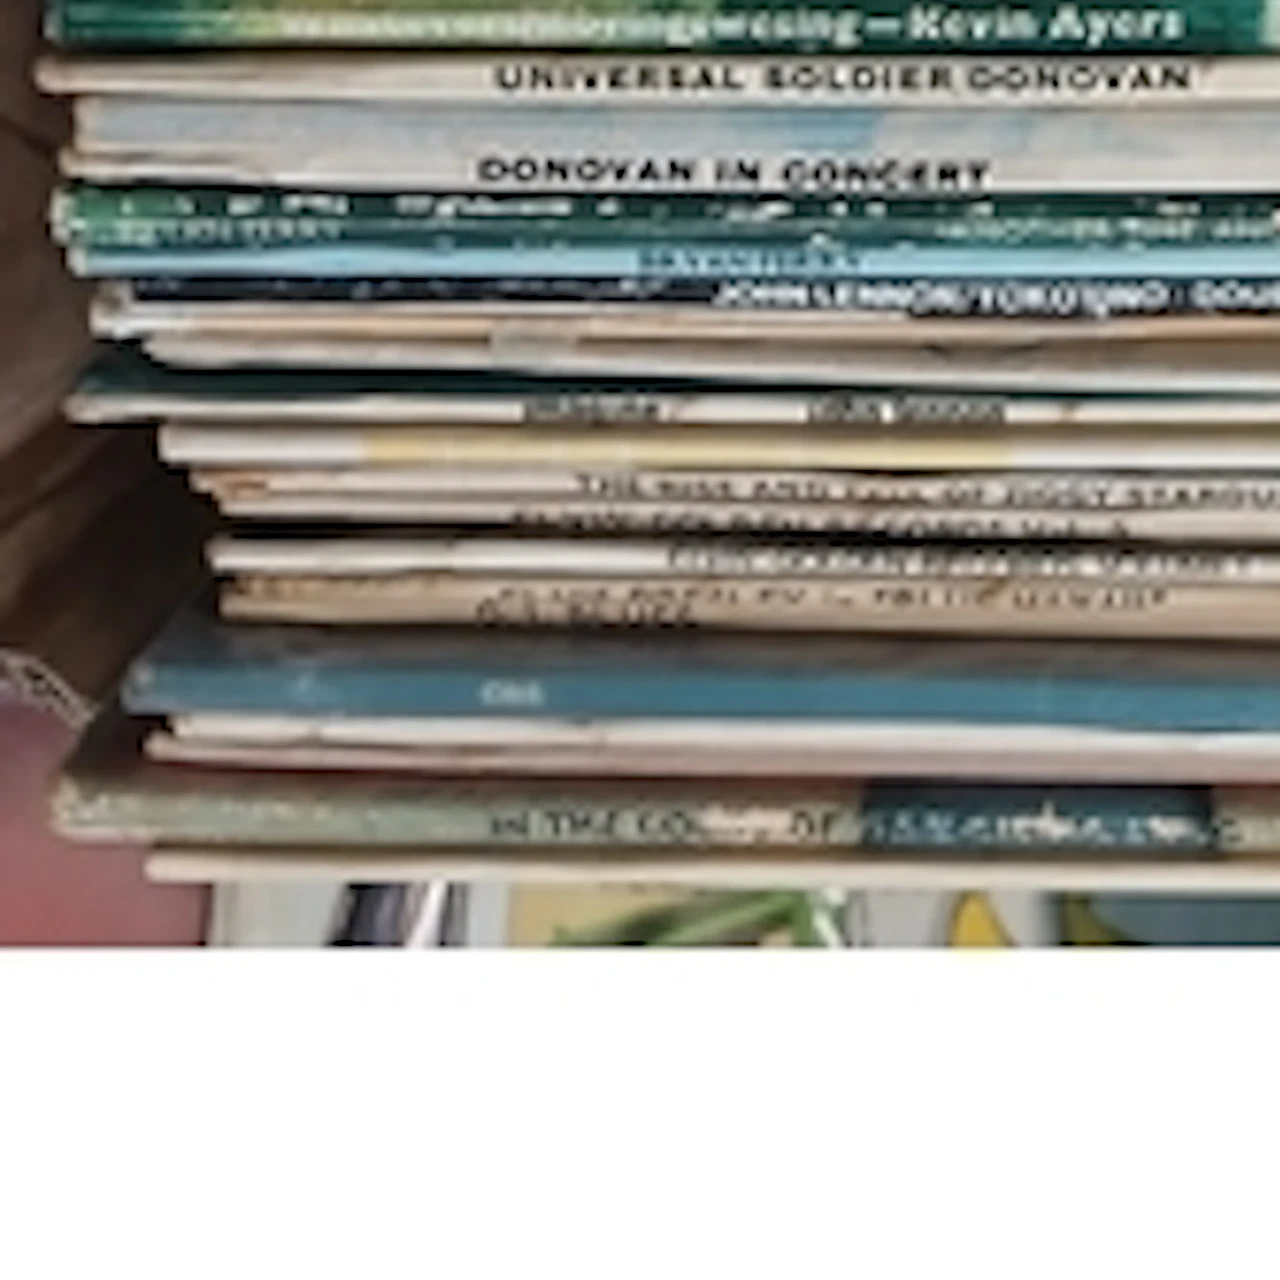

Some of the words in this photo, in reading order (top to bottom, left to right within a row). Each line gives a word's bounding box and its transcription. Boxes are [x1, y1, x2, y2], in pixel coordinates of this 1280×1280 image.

[907, 5, 1033, 42] Kevin
[1046, 5, 1184, 47] Ayers
[493, 65, 745, 93] UNIVERSAL
[764, 64, 955, 91] SOLDIER
[967, 63, 1190, 91] DONOVAN
[476, 158, 696, 186] DONOVAN
[713, 158, 761, 186] IN
[784, 157, 993, 187] CONCERT
